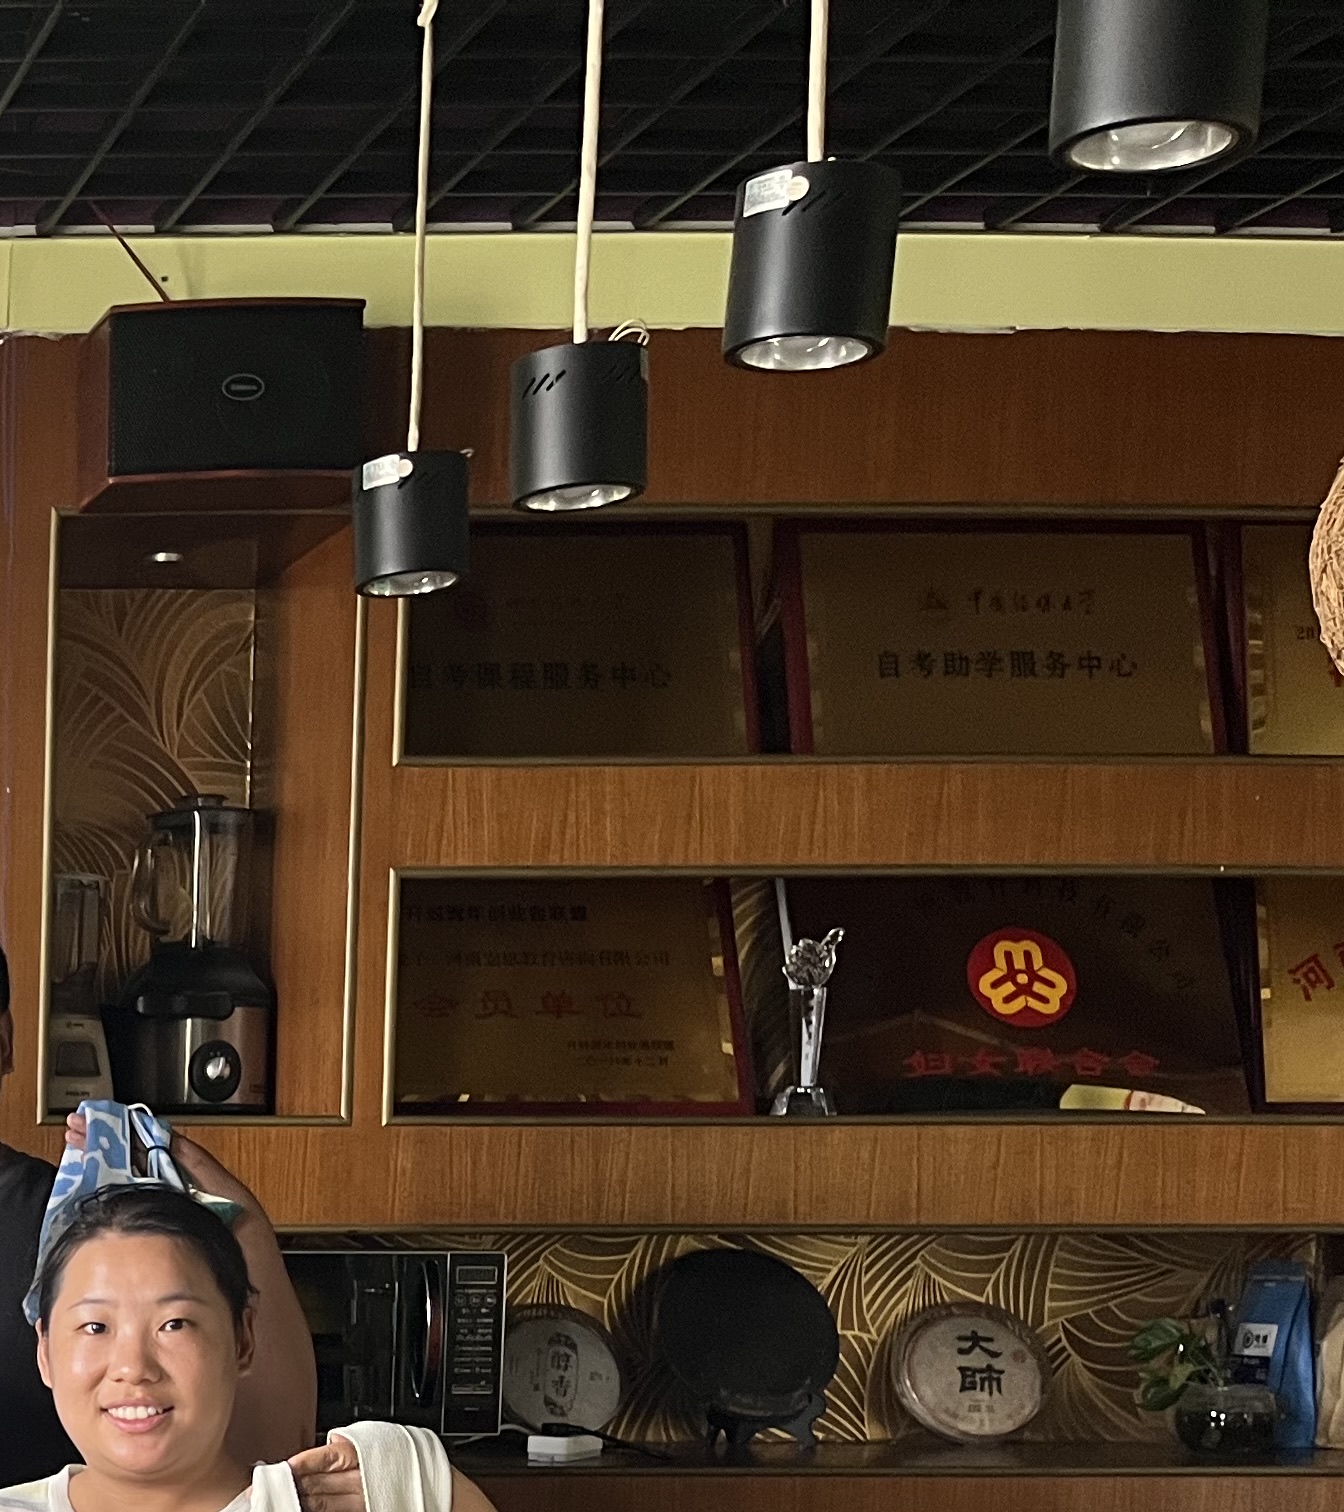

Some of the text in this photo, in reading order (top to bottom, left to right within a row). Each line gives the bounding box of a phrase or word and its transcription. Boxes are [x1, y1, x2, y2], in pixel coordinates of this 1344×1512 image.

[876, 650, 1138, 679] 自考助学服务中心
